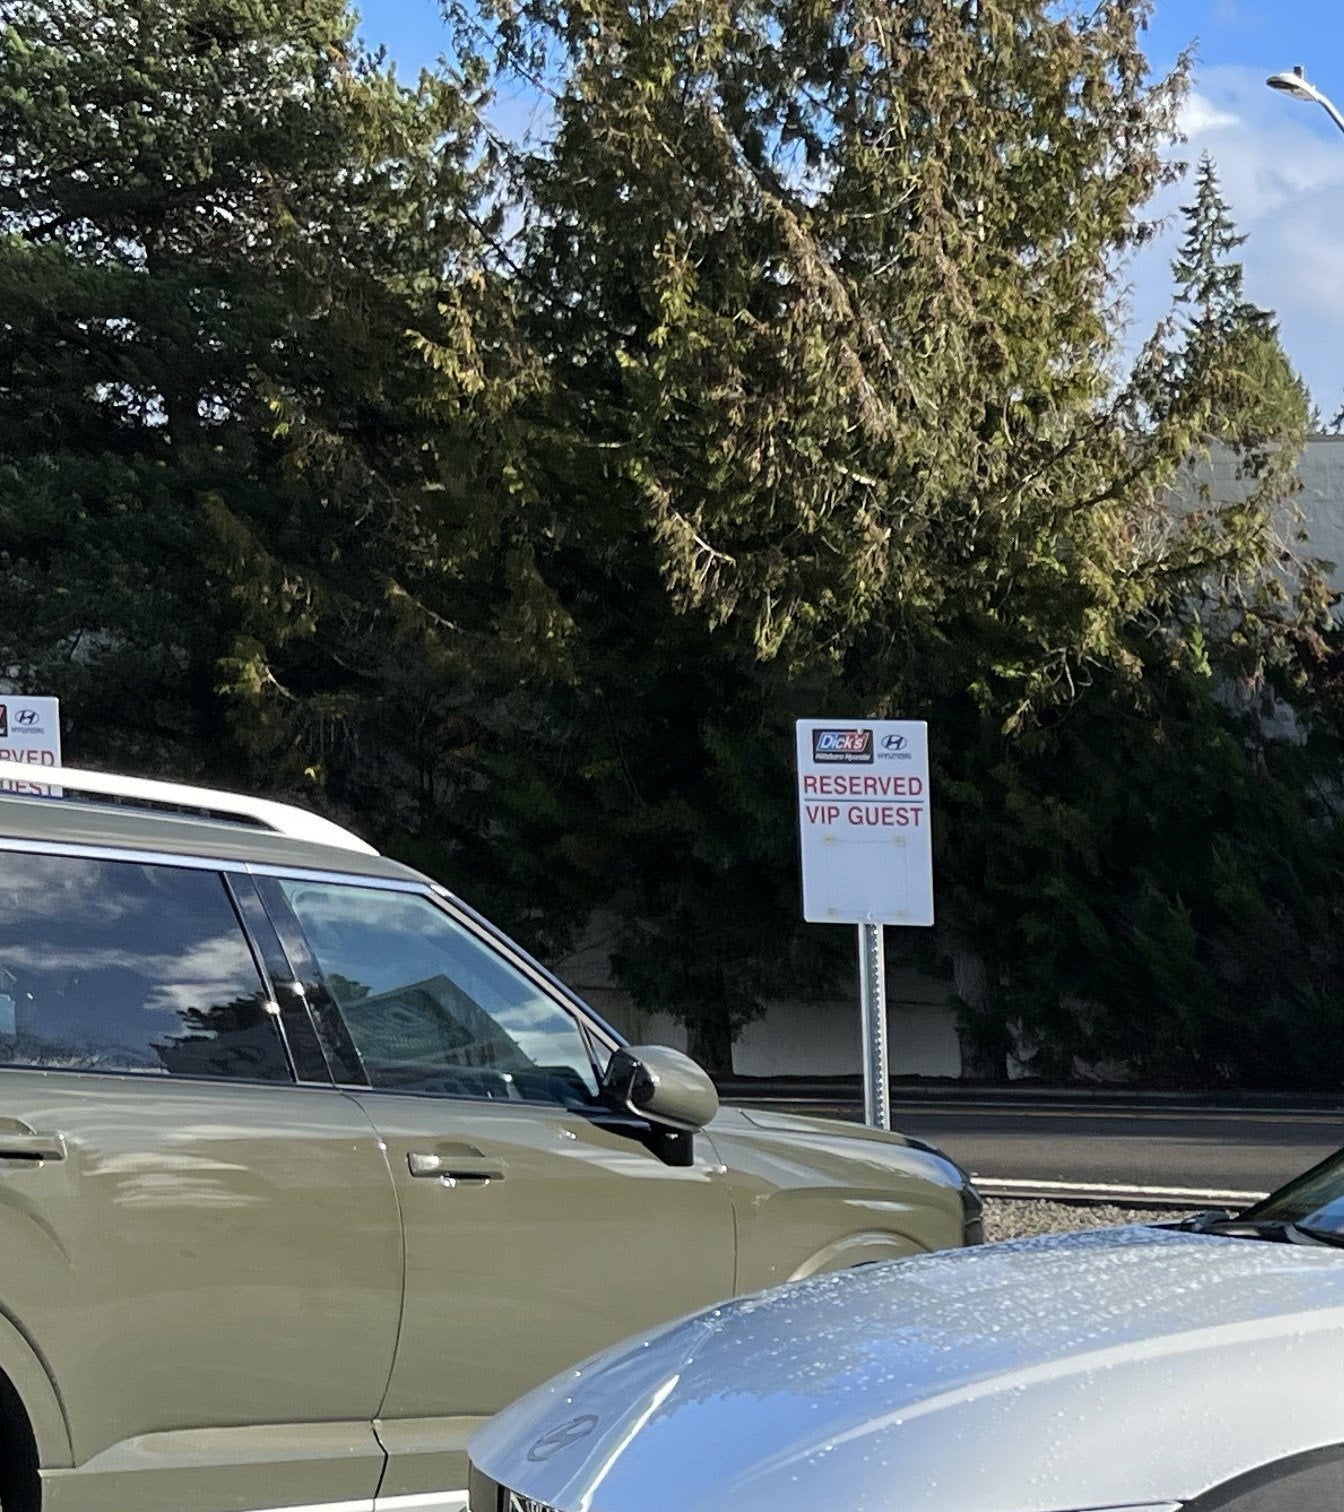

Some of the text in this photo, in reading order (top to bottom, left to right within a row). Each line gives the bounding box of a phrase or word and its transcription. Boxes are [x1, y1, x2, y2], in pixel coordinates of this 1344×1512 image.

[804, 775, 923, 796] RESERVED
[806, 805, 923, 827] VIP GUEST
